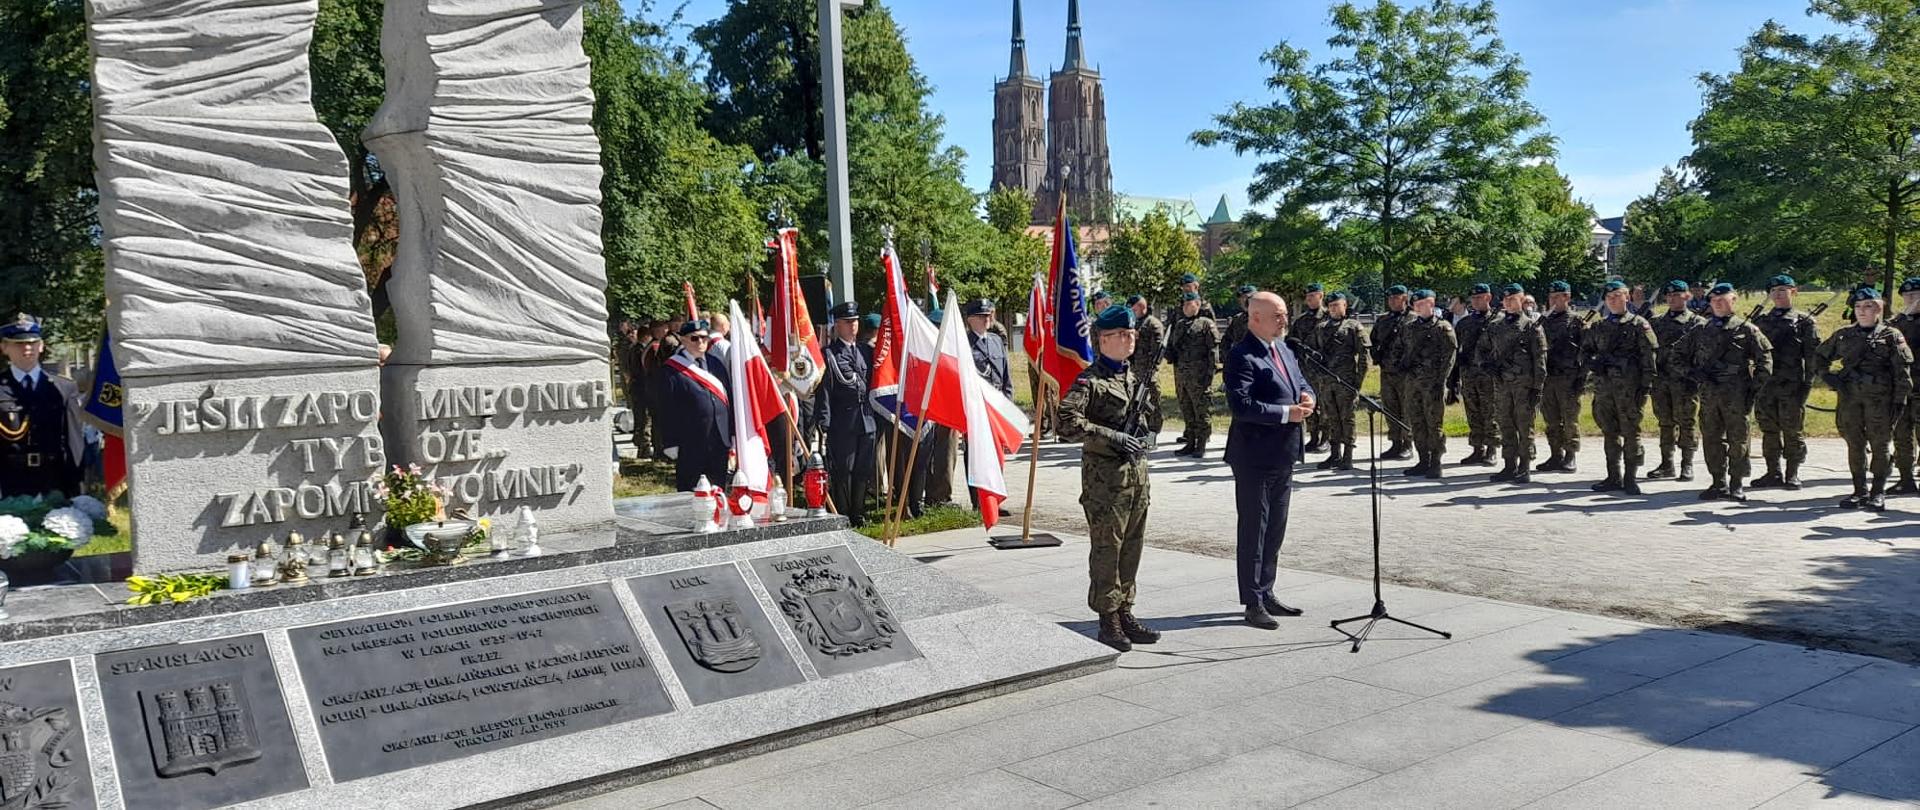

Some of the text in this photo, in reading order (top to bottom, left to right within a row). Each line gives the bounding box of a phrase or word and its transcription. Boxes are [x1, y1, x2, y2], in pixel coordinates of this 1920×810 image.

[271, 390, 379, 427] ZAPO
[505, 384, 529, 413] O
[533, 380, 611, 411] NICH
[290, 436, 355, 473] TY
[364, 435, 385, 468] B
[461, 472, 484, 504] O
[771, 554, 838, 572] TARNOPOL
[320, 592, 591, 640] OBYWATELOM POLSKIM POMORDOWANYM
[323, 645, 346, 656] NA
[351, 633, 415, 651] KRESACH
[519, 604, 600, 625] WSCHODNICH
[401, 650, 414, 660] W
[421, 640, 471, 656] LATACH
[479, 634, 506, 646] 1939
[460, 651, 503, 666] PRZEZ
[525, 644, 630, 671] NACJONALISTÓW
[471, 717, 525, 735] KRESOWE
